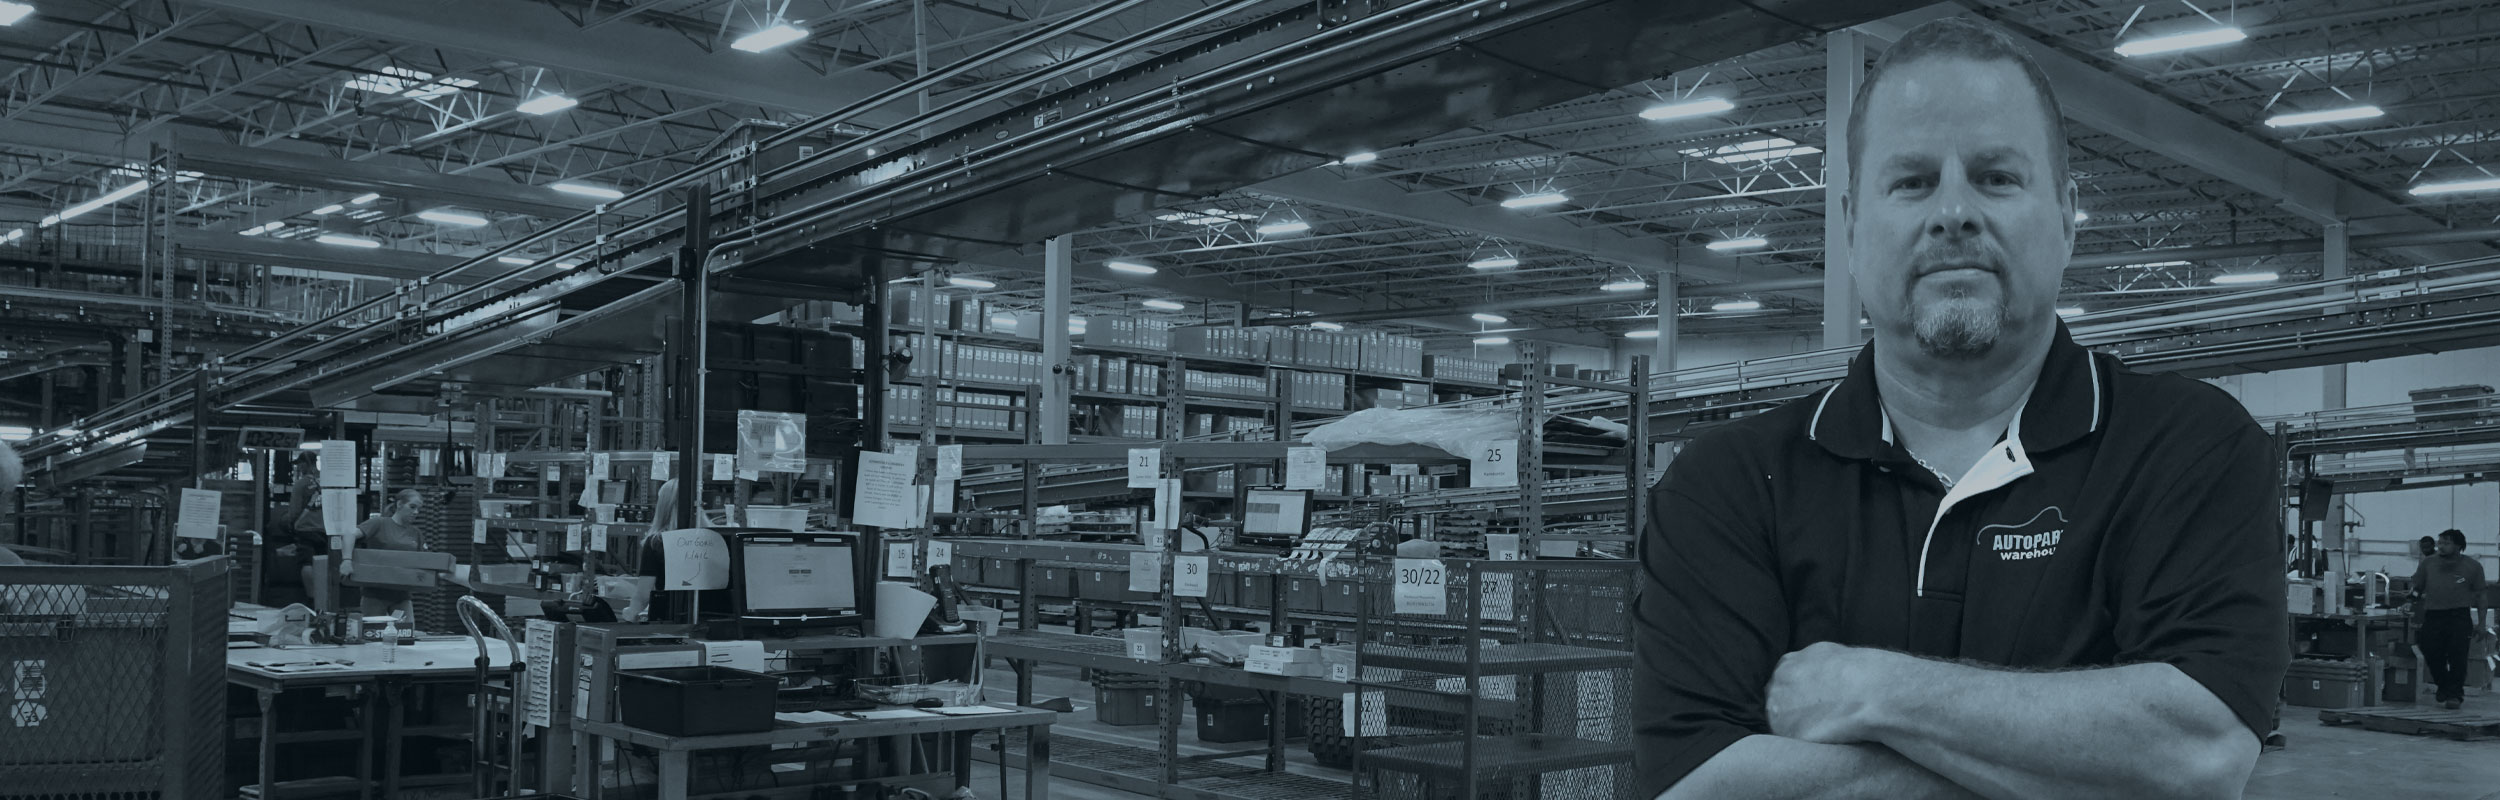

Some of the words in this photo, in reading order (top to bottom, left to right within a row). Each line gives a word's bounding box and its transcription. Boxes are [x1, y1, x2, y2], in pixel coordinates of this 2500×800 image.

[1487, 448, 1502, 462] 25
[1139, 456, 1149, 467] 21
[1992, 529, 2064, 550] AUTOPAR
[936, 547, 944, 558] 24
[1504, 553, 1513, 561] 25
[1186, 563, 1198, 575] 30
[1401, 567, 1440, 587] 30/22
